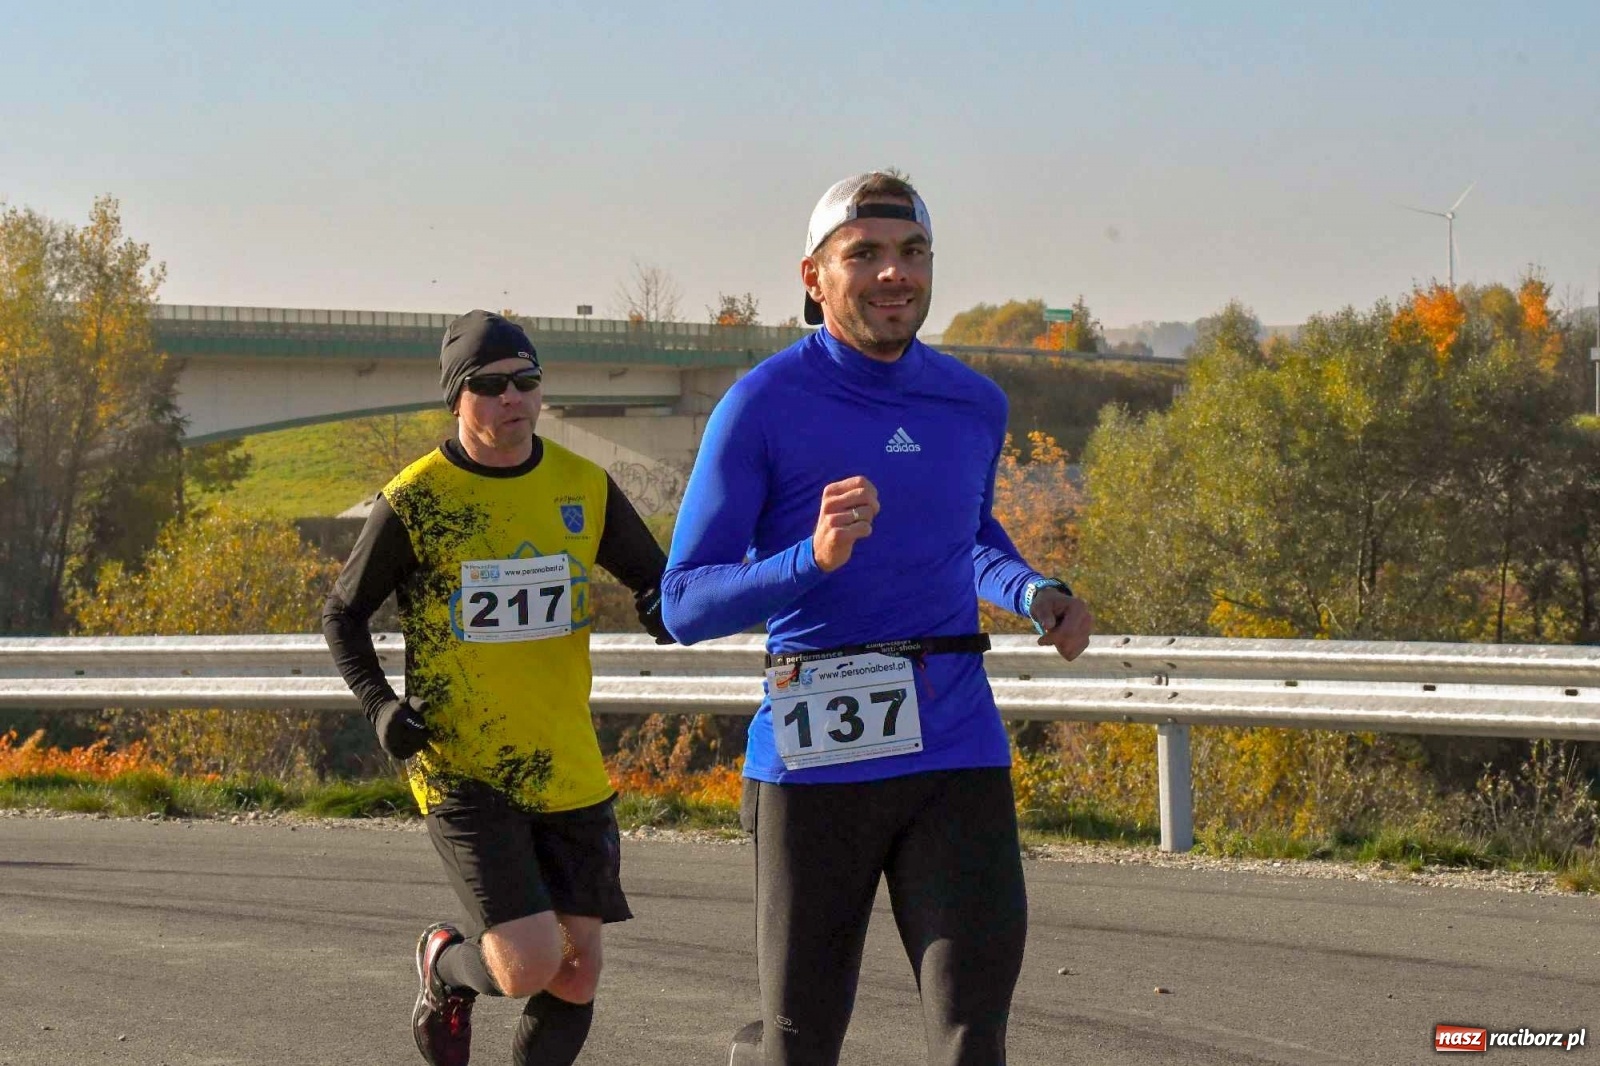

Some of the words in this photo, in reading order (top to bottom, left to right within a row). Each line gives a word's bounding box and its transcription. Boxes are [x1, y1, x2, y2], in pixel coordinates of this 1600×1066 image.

[885, 443, 921, 452] adidas
[469, 585, 565, 627] 217
[786, 651, 844, 664] performance
[818, 660, 906, 681] www.personalbest.pl
[784, 688, 908, 749] 137
